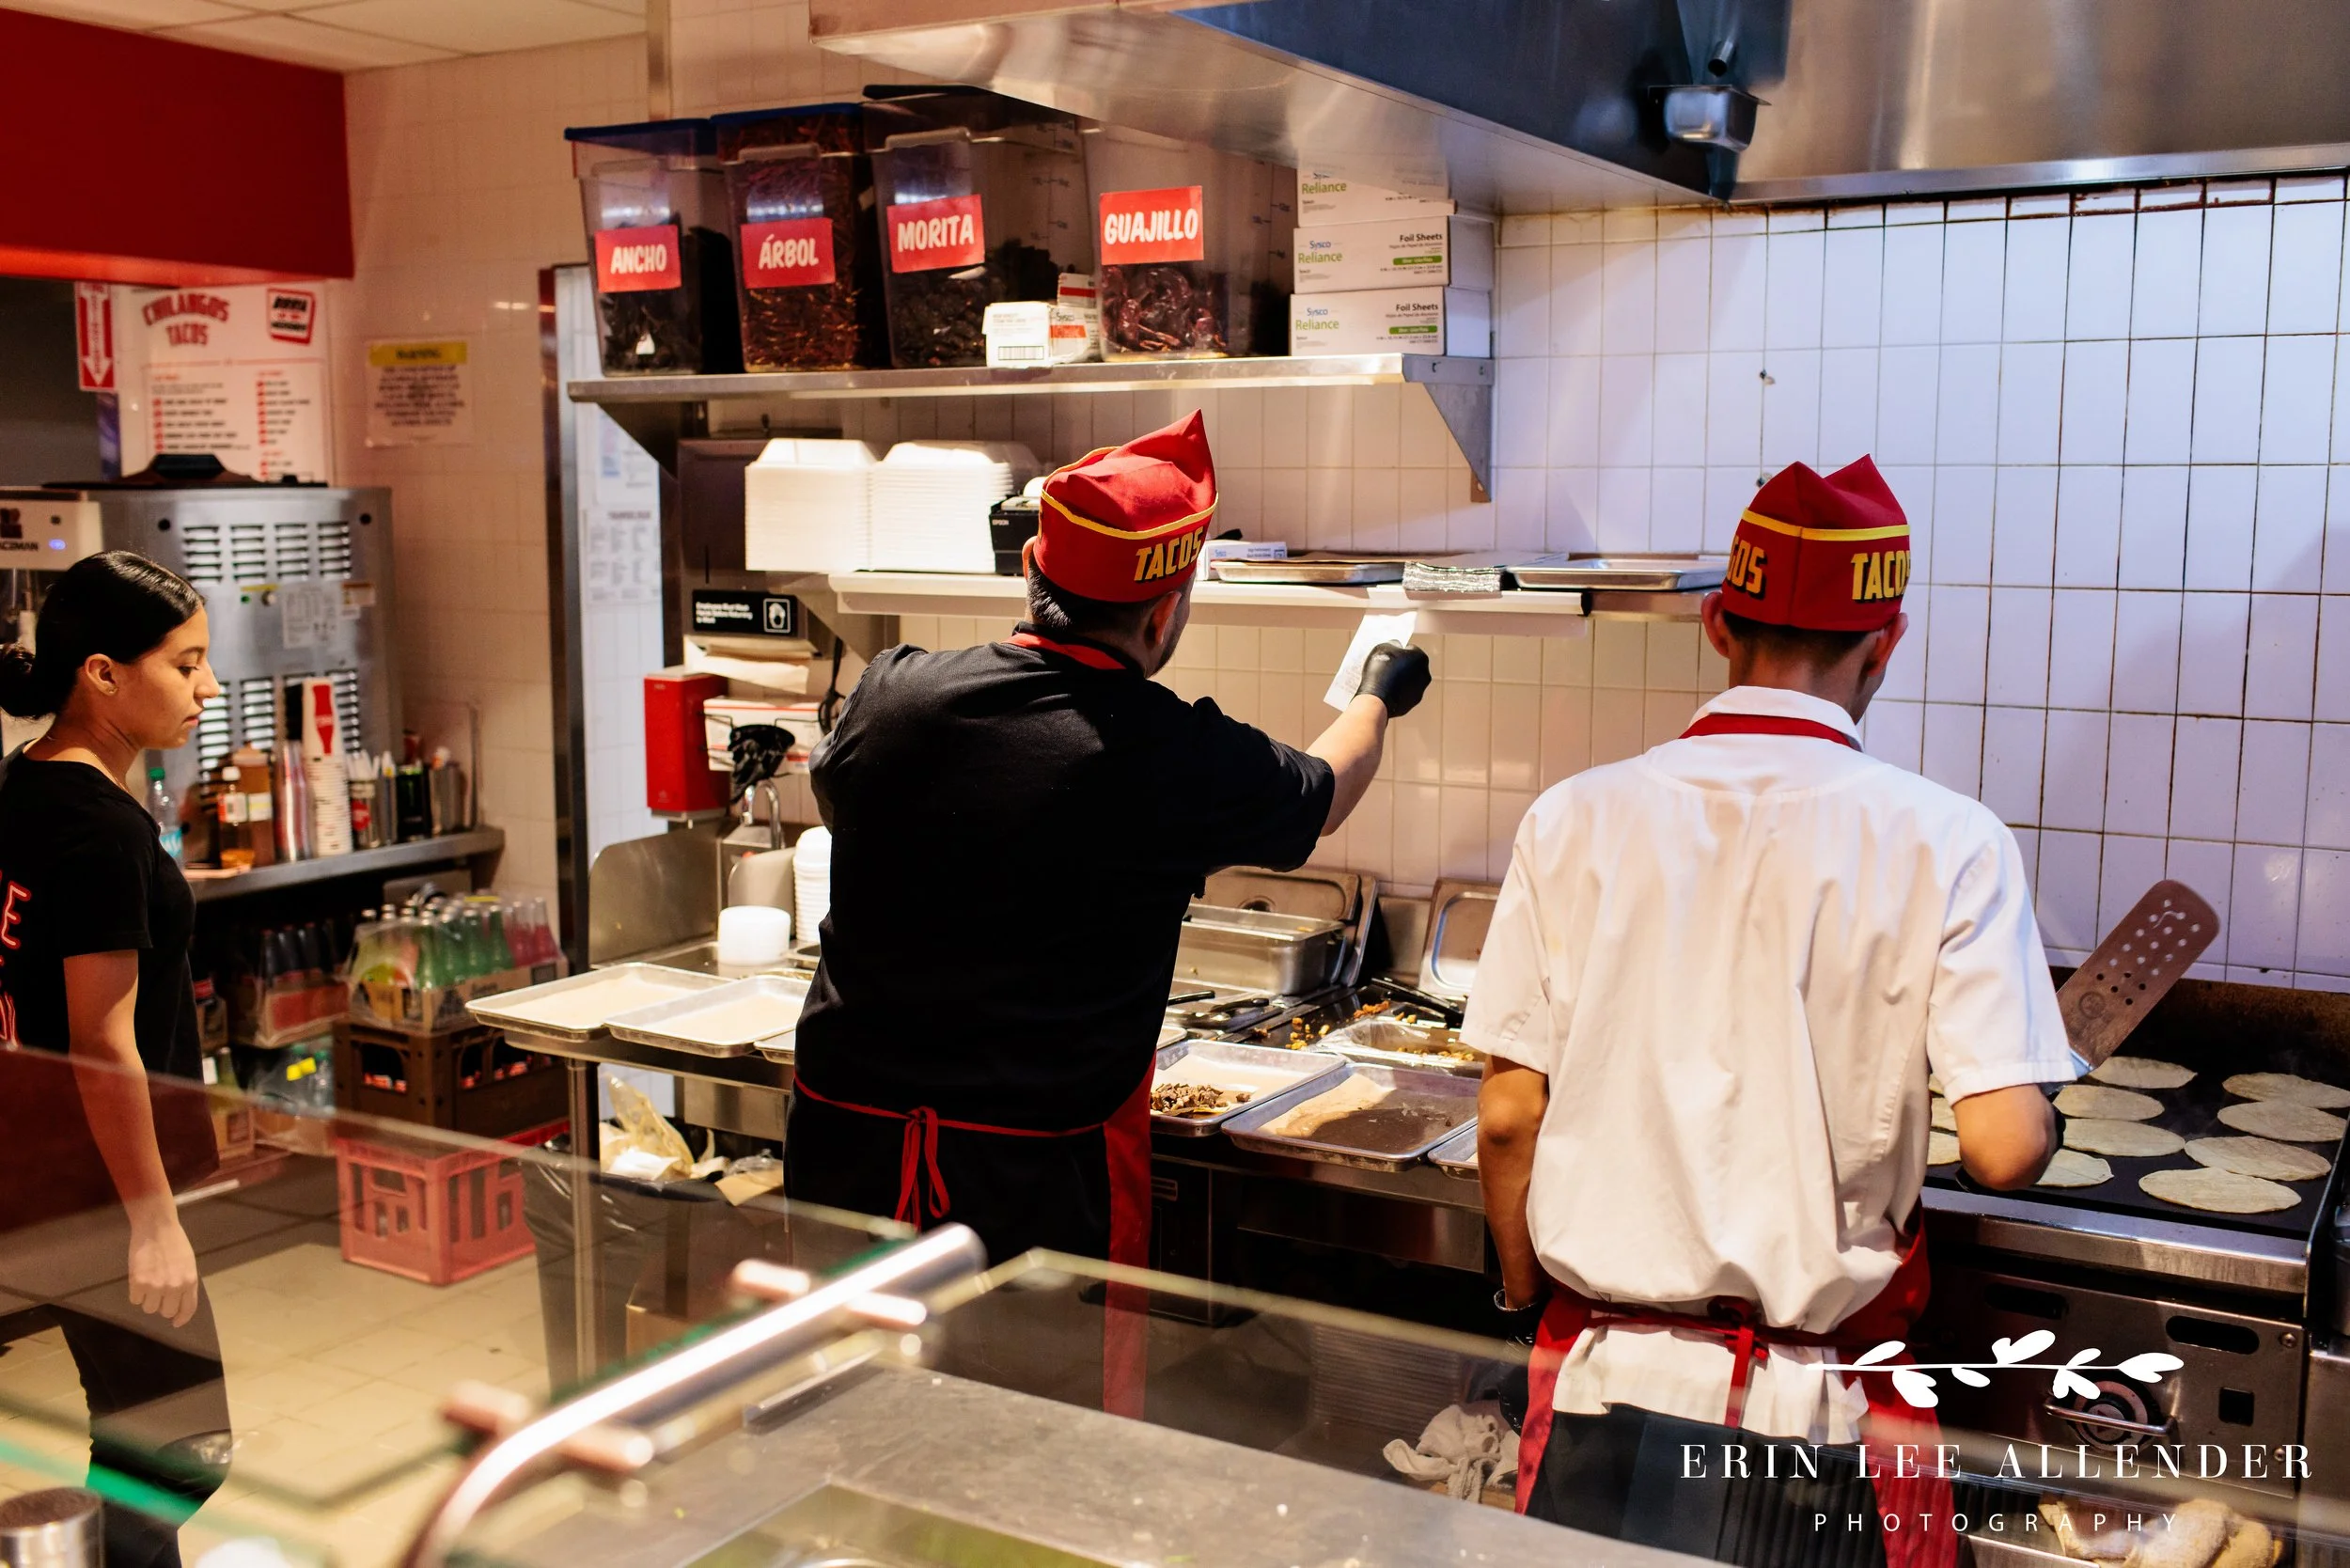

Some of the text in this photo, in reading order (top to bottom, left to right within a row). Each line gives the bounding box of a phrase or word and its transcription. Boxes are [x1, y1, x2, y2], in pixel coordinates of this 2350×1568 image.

[1302, 182, 1347, 194] Reliance
[1104, 208, 1198, 245] GUAJILLO
[898, 215, 975, 253] MORITA
[1400, 232, 1443, 243] Foil Sheets
[1309, 241, 1332, 250] Sysco
[610, 243, 667, 274] ANCHO
[758, 234, 820, 271] ÁRBOL
[1298, 252, 1342, 264] Reliance
[1307, 307, 1328, 318] Sysco
[1396, 302, 1439, 312] Foil Sheets
[1295, 319, 1340, 331] Reliance
[165, 323, 209, 346] TACOS
[1134, 526, 1204, 581] TACOS
